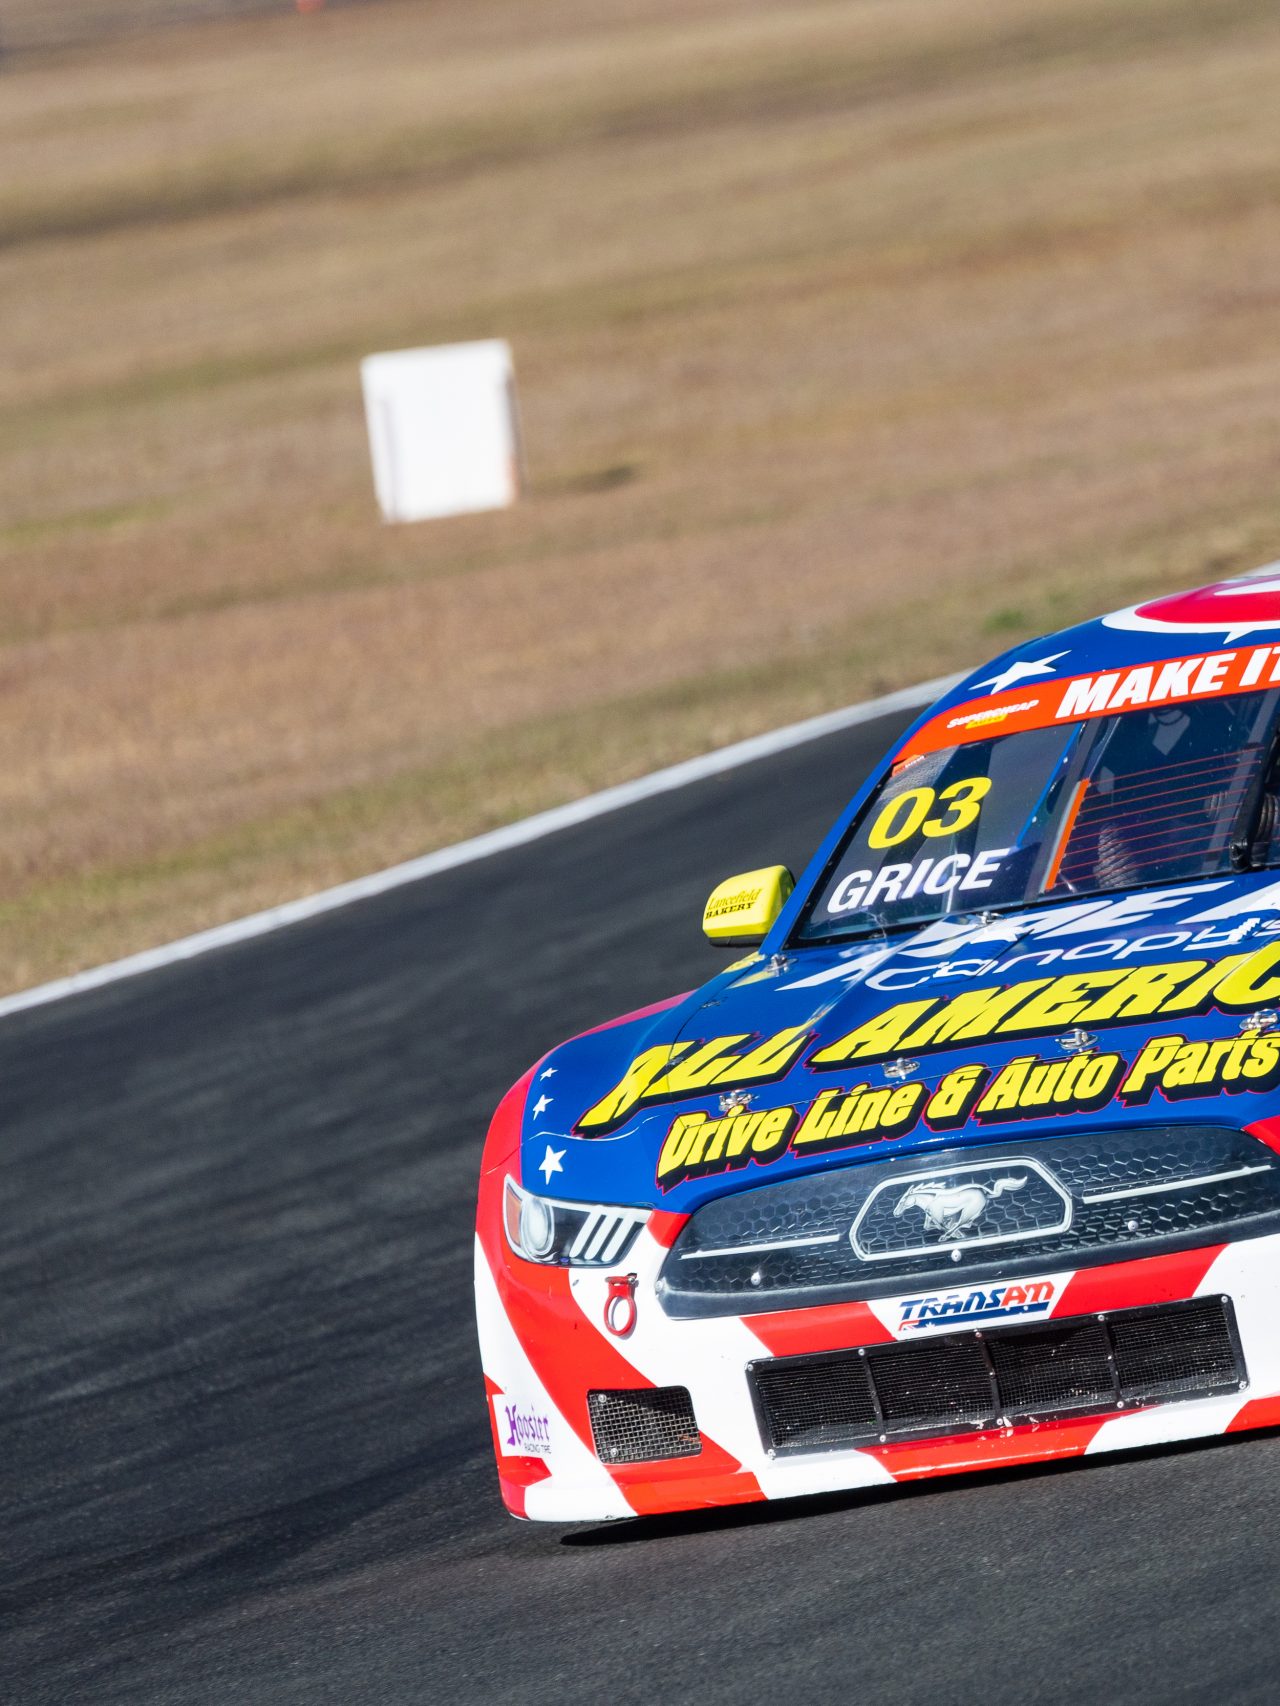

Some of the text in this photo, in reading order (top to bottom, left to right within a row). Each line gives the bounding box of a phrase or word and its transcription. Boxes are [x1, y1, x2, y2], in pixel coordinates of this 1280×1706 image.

[947, 699, 1040, 729] SUPERCHEAP
[1055, 650, 1236, 719] MAKE
[868, 777, 992, 849] 03
[705, 901, 755, 920] BAKERY
[708, 888, 763, 910] Lancefield
[828, 848, 1010, 913] GRICE
[578, 1018, 815, 1127] ALL
[657, 1105, 796, 1178] Drive
[794, 1082, 922, 1144] Line
[927, 1066, 986, 1118] &
[978, 1050, 1118, 1113] Auto
[505, 1404, 549, 1446] Hoosier
